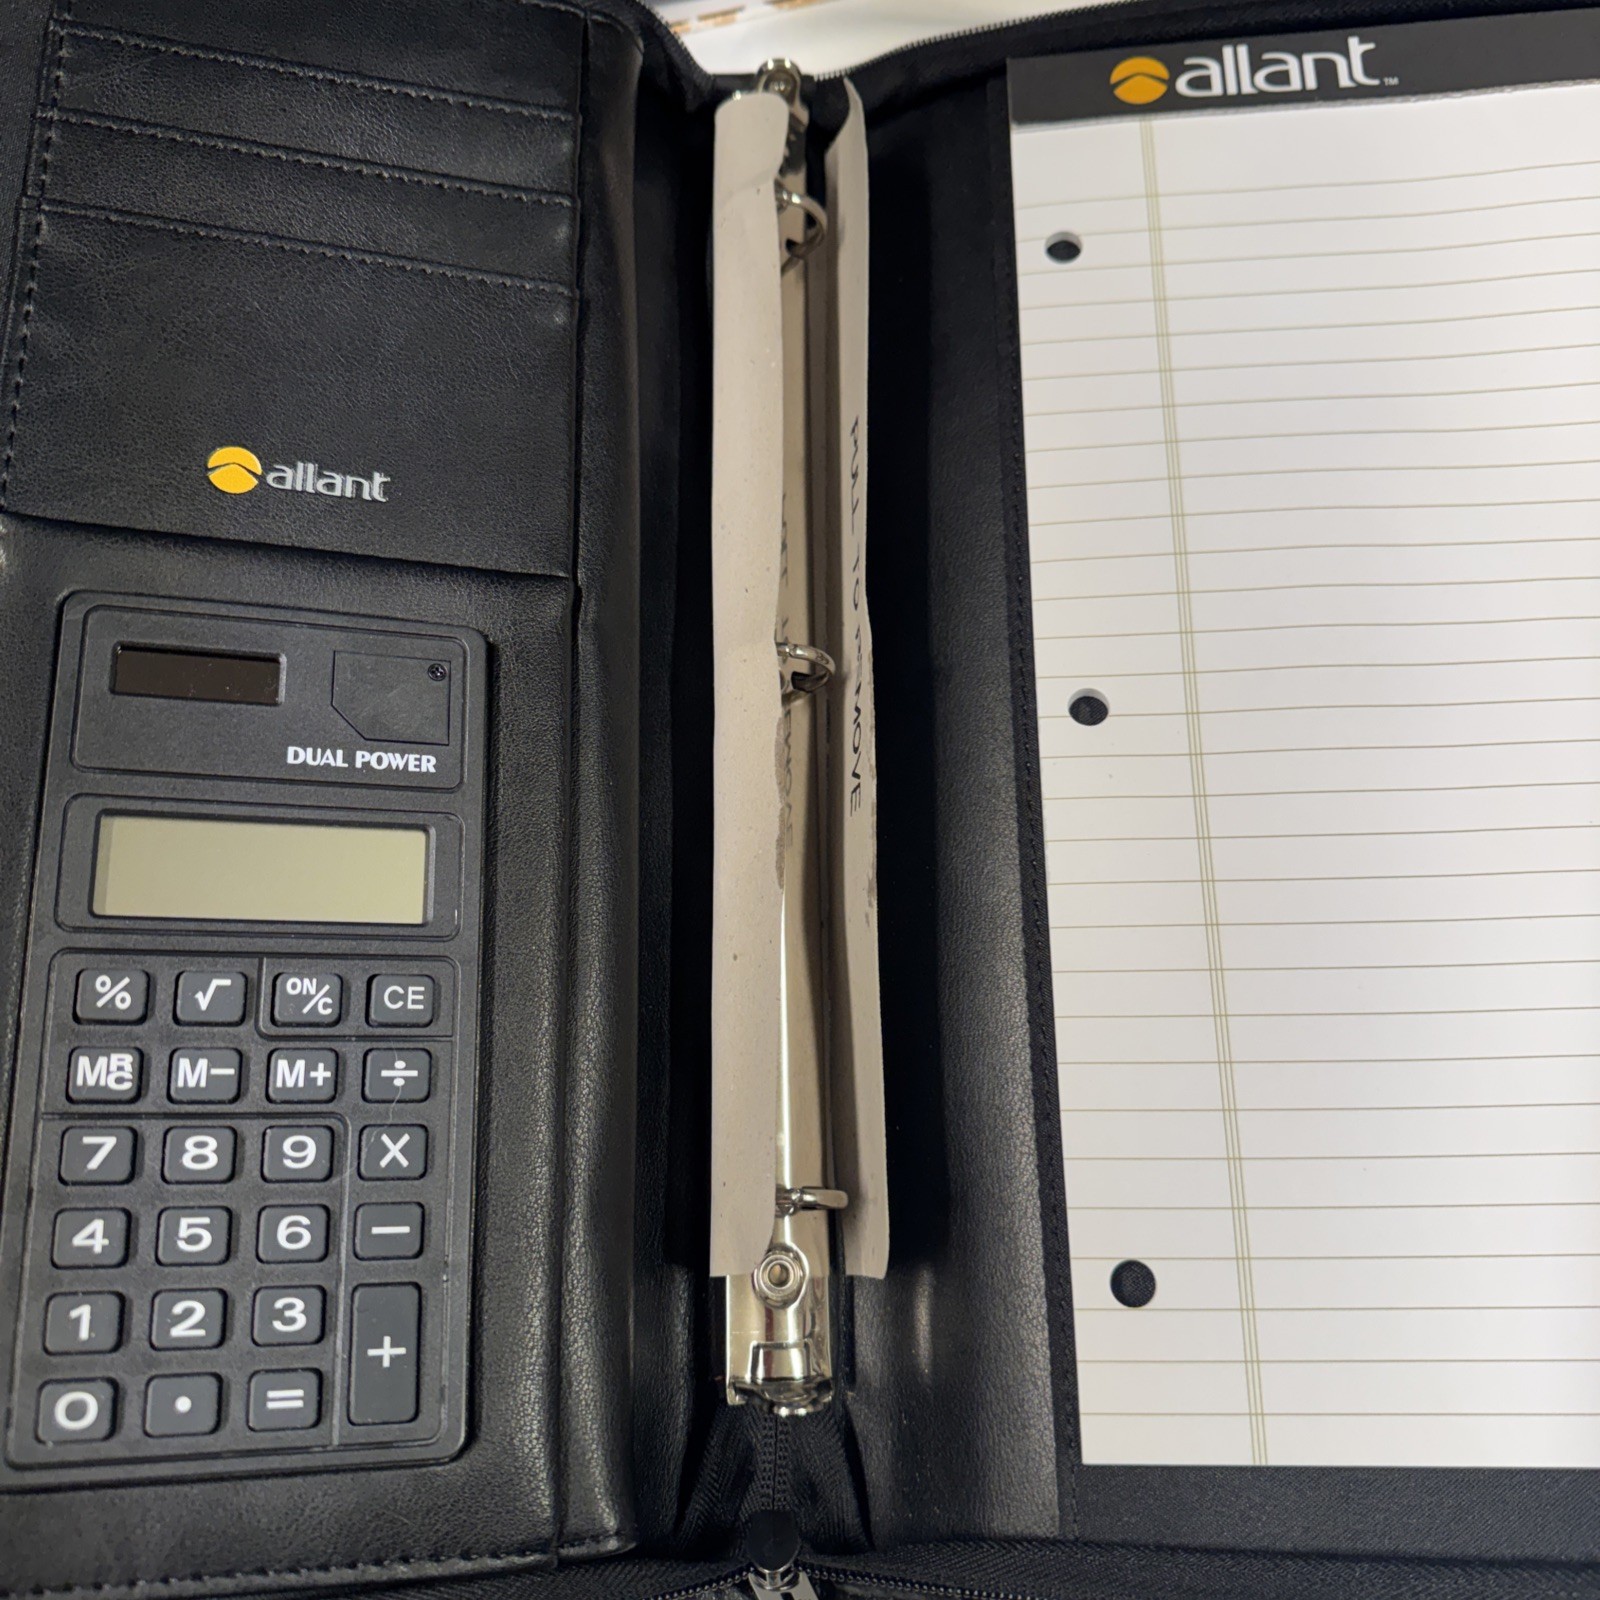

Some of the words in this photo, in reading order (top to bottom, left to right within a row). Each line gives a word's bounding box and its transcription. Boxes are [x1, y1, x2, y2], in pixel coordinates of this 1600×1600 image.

[1174, 35, 1381, 98] allant
[265, 460, 392, 503] allant
[286, 745, 349, 768] DUAL
[354, 750, 437, 773] POWER
[383, 985, 426, 1010] CE
[82, 1135, 118, 1171] 7
[180, 1134, 219, 1171] 8
[282, 1134, 317, 1170] 9
[71, 1218, 110, 1255] 4
[176, 1216, 213, 1253] 5
[276, 1214, 312, 1251] 6
[69, 1303, 95, 1341] 1
[167, 1299, 207, 1338] 2
[271, 1296, 307, 1333] 3
